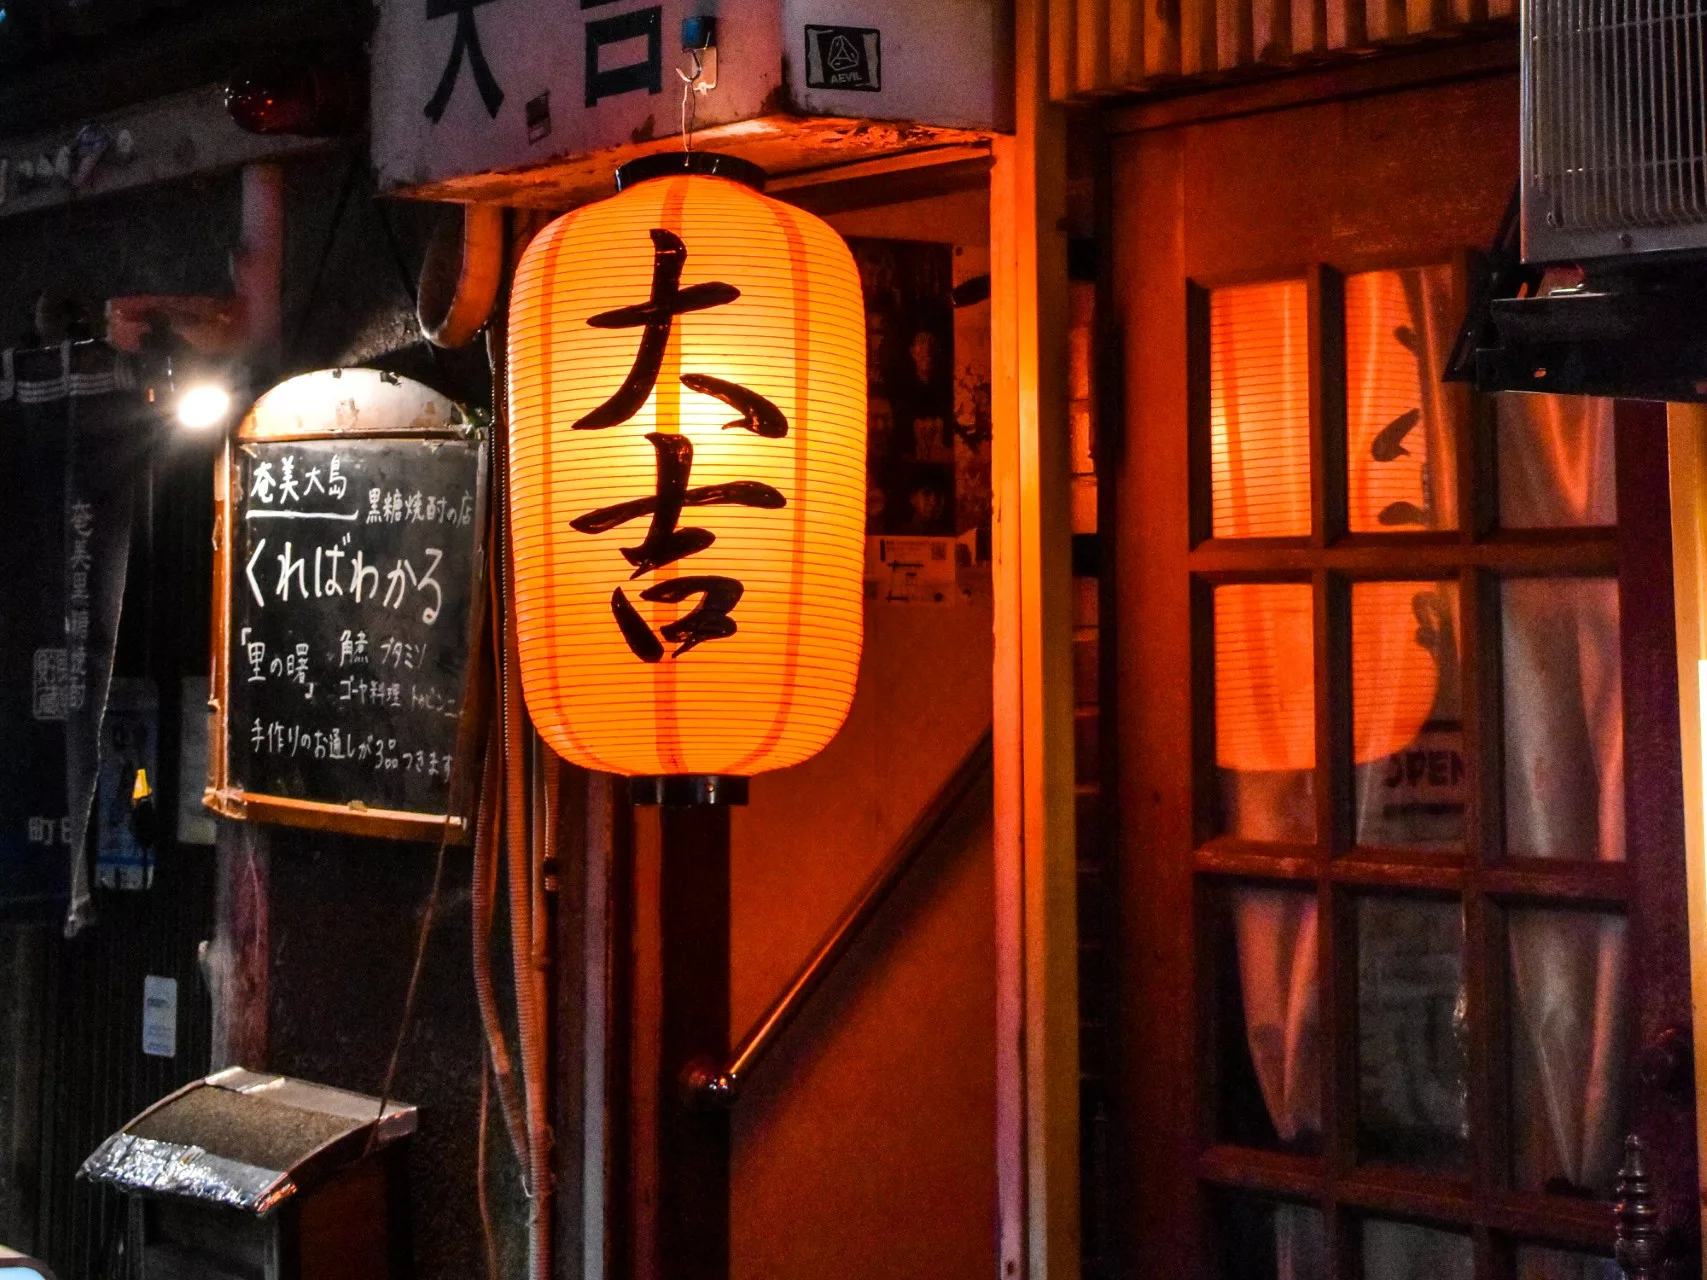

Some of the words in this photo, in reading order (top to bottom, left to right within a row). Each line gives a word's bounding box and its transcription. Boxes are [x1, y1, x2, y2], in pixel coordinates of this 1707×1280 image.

[251, 454, 347, 504] 奄美大島
[570, 228, 789, 663] 大吉
[366, 487, 473, 528] 黒糖焼酎の店
[246, 532, 443, 625] くればわかる
